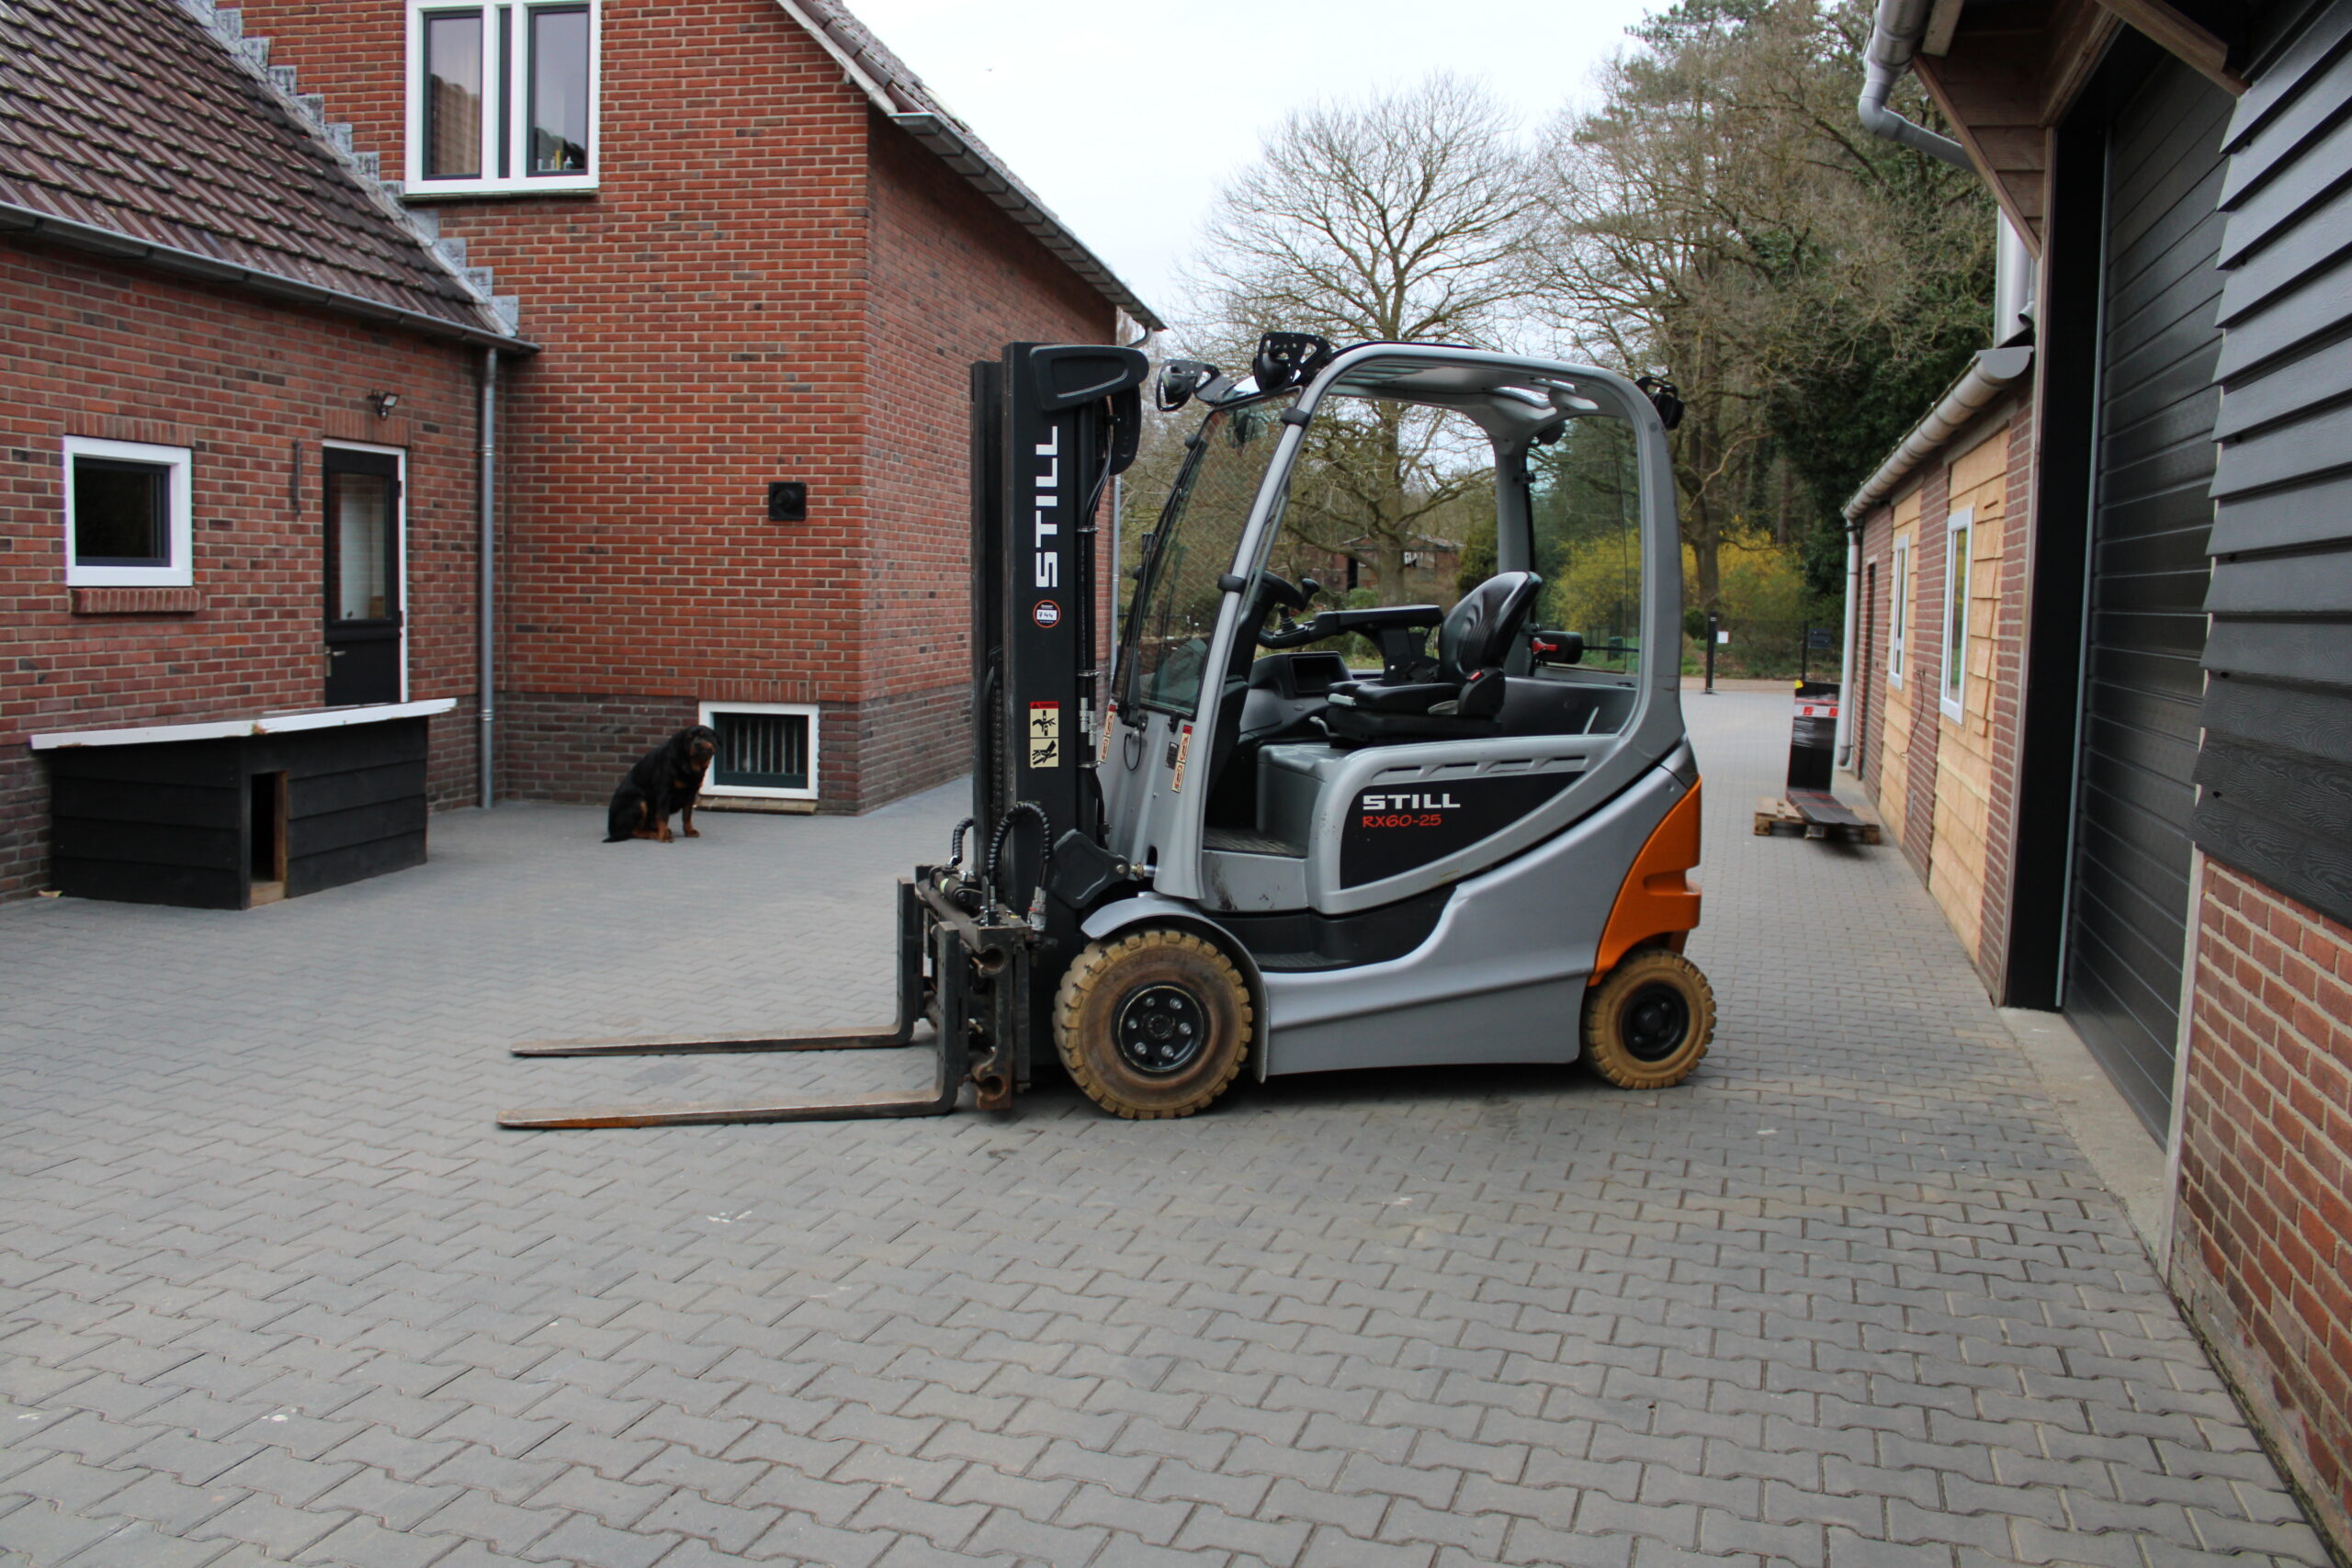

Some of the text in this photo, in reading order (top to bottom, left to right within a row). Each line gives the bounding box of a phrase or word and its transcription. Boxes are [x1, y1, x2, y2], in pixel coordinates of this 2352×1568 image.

[1035, 425, 1058, 588] STILL
[1363, 793, 1461, 810] STILL
[1363, 814, 1442, 828] RX60-25
